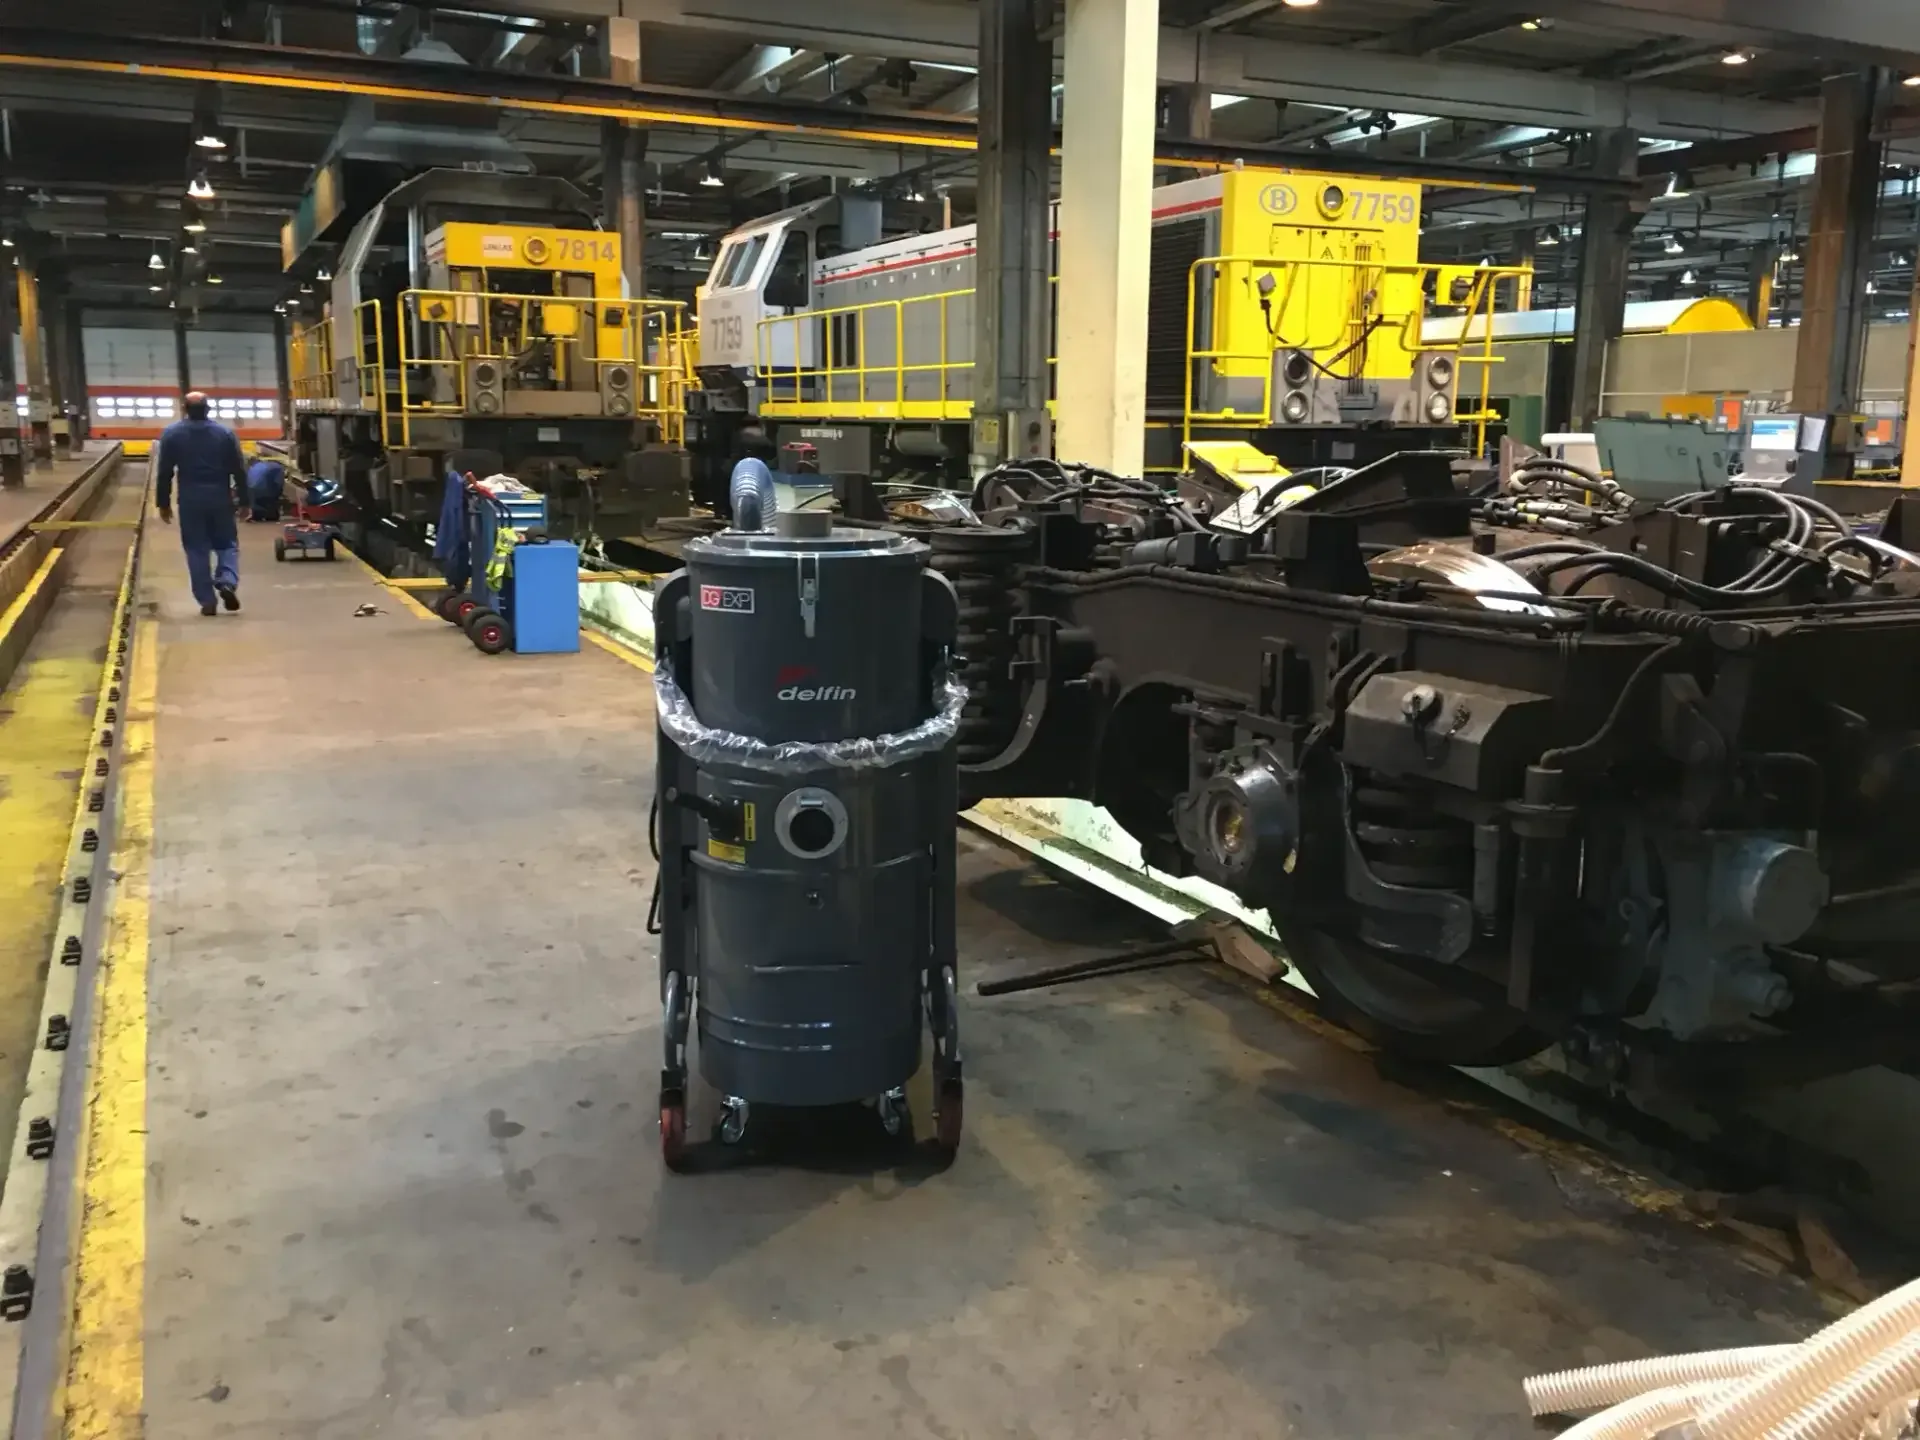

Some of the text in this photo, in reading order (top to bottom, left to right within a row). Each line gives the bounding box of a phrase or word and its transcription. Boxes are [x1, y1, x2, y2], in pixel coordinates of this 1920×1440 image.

[1350, 191, 1415, 224] 7759
[556, 238, 616, 262] 7814
[711, 315, 742, 352] 7759
[702, 589, 750, 608] DG EXP
[777, 686, 857, 702] delfin
